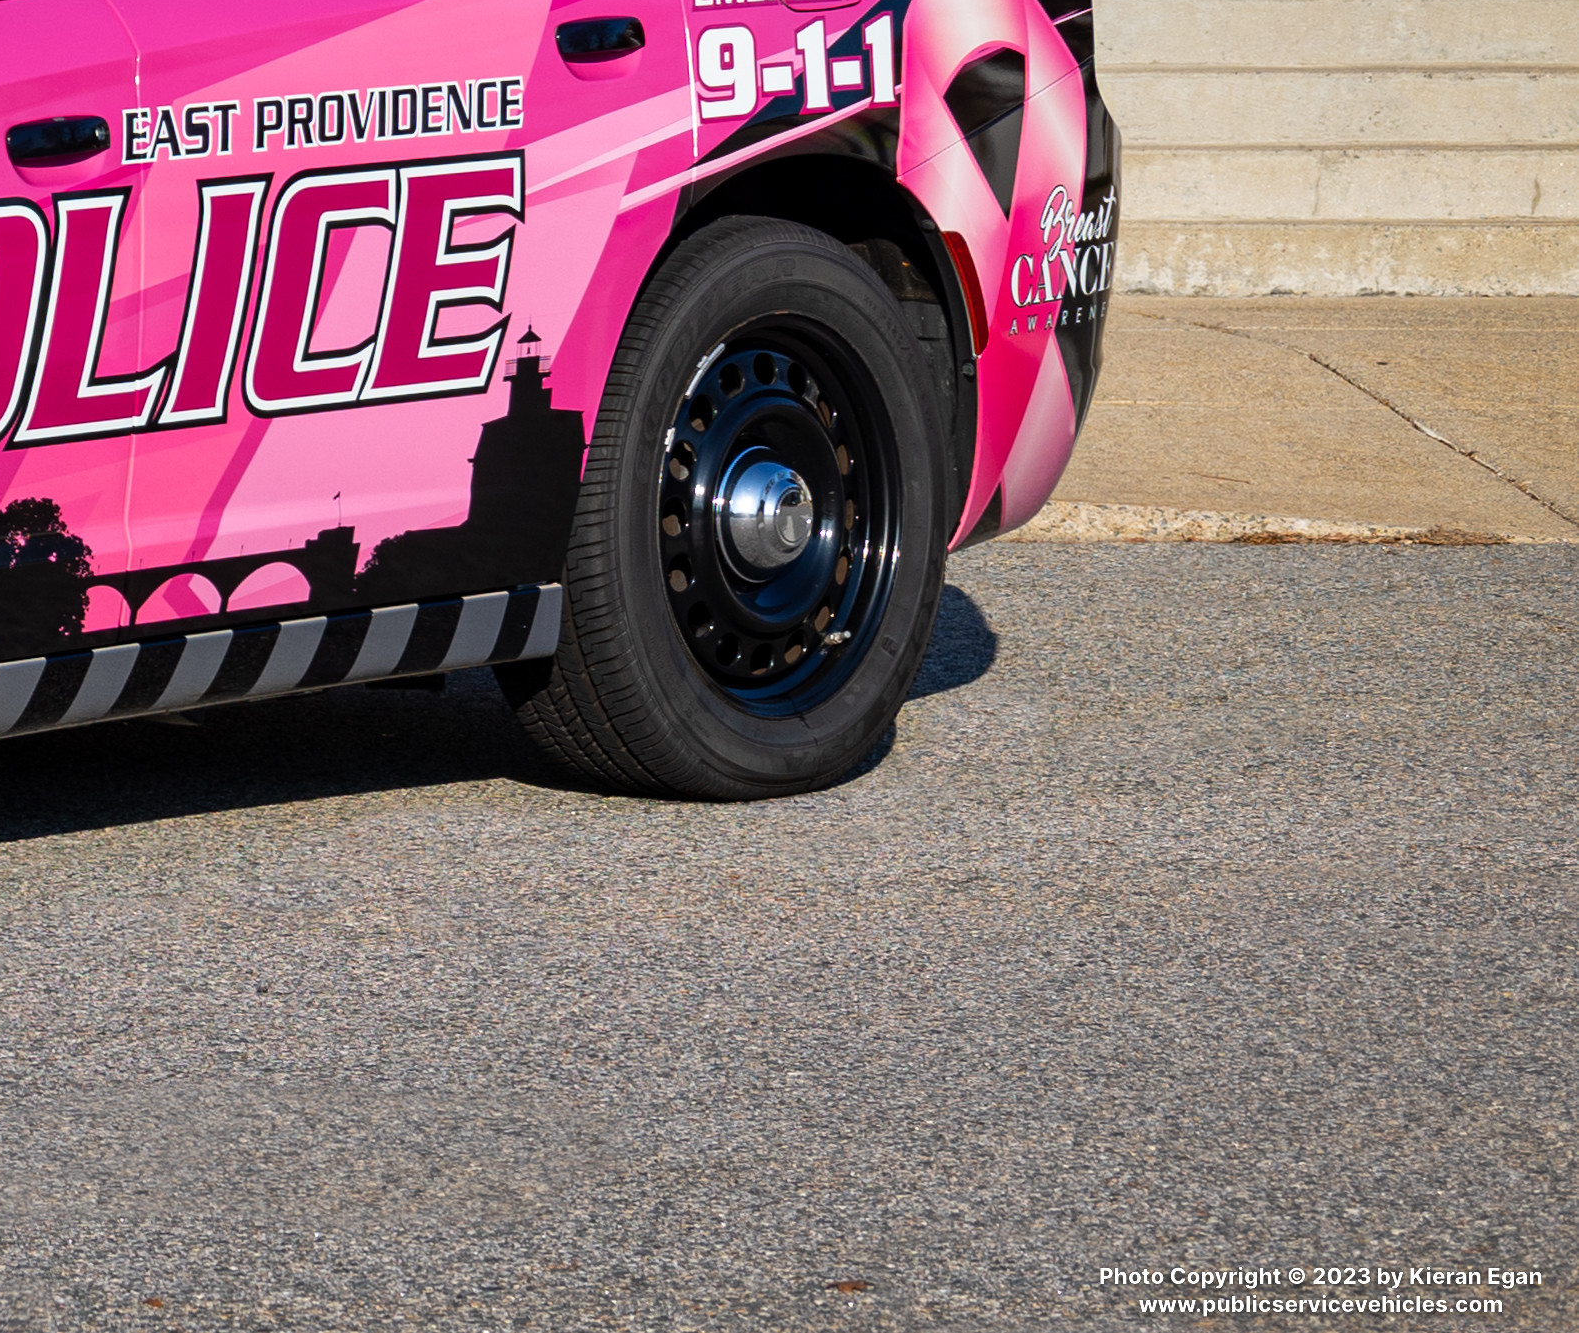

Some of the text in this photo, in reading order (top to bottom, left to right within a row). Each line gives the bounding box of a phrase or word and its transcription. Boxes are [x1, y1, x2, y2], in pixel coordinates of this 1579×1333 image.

[696, 11, 899, 123] 9-1-1
[121, 76, 525, 165] EAST PROVIDENCE
[1040, 184, 1116, 262] Breast
